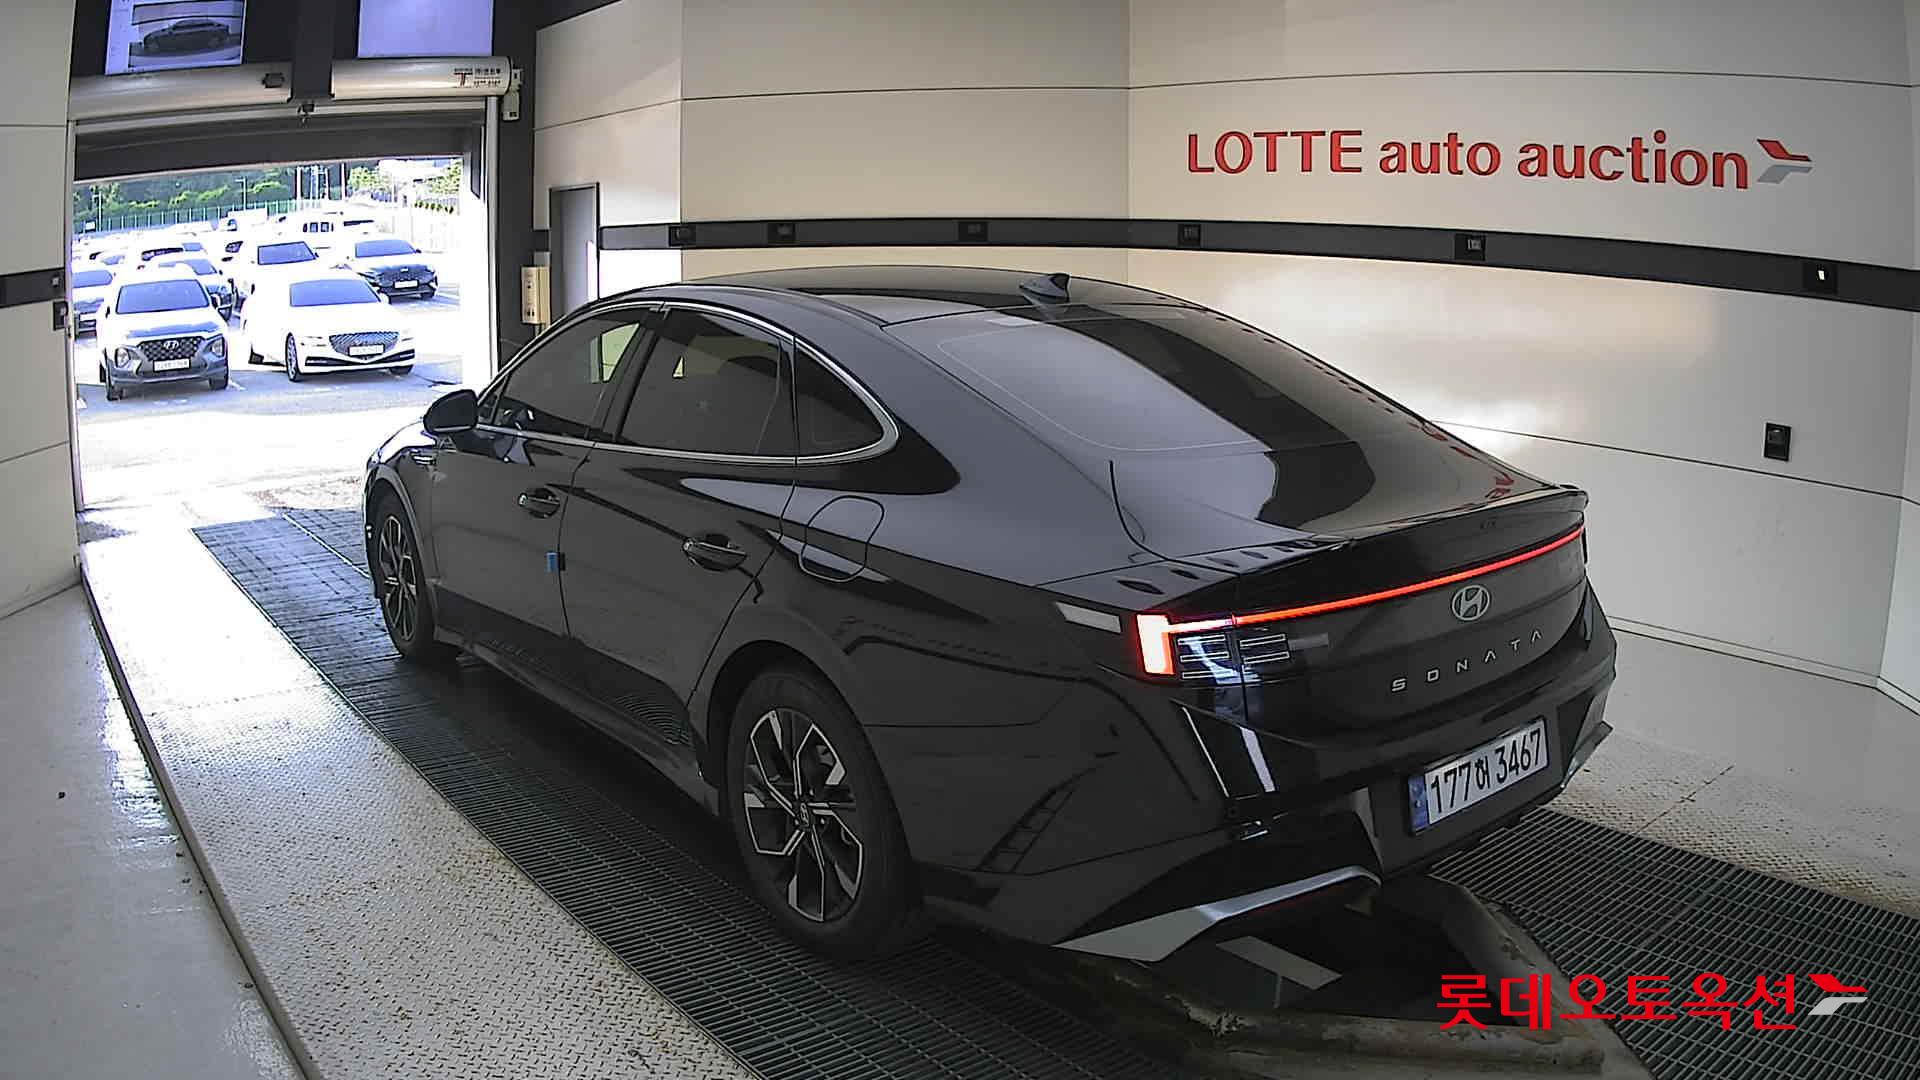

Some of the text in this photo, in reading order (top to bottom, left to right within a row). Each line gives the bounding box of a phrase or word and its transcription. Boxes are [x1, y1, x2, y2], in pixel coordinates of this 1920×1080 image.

[1188, 130, 1748, 189] LOTTE auto auction
[1391, 629, 1543, 692] SONATA
[1431, 728, 1541, 814] 177허 3467
